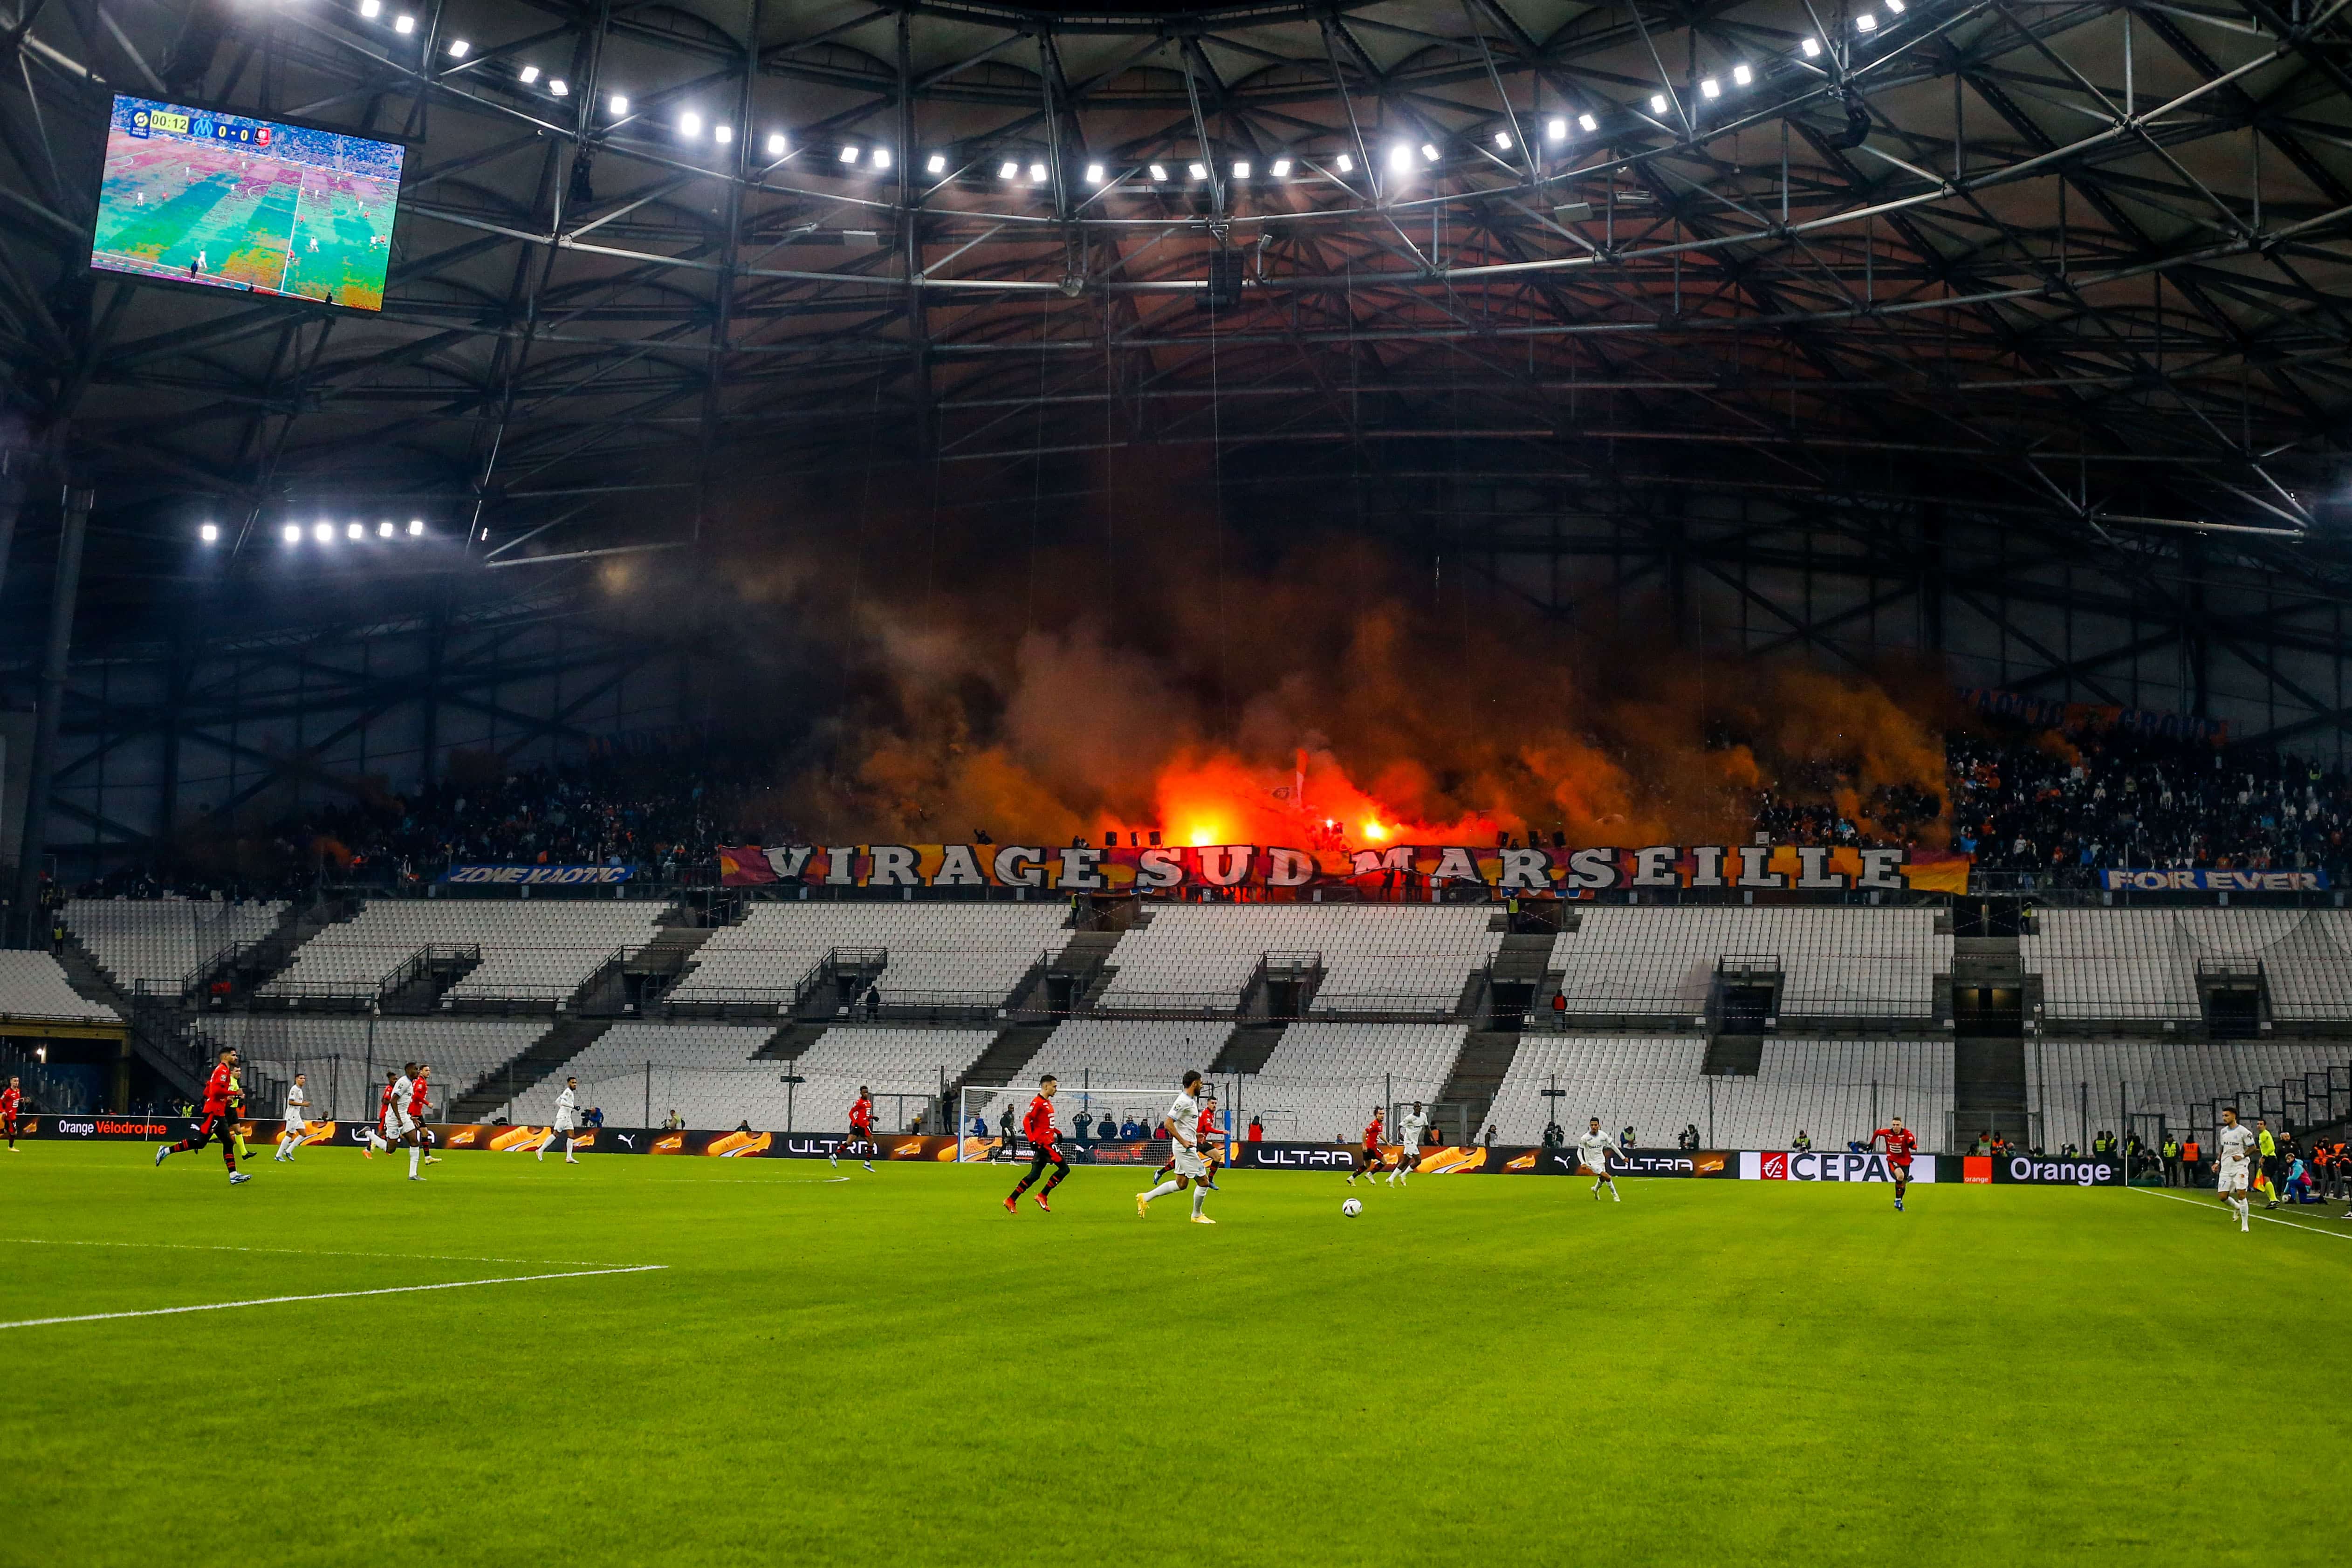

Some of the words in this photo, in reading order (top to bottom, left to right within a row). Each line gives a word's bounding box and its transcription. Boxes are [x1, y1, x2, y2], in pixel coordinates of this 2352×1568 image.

[151, 114, 187, 130] 00:12
[450, 867, 530, 883] ZONE
[521, 867, 625, 884] KAOTIC
[762, 845, 1101, 888] VIRAGE
[1135, 845, 1313, 887] SUD
[1352, 847, 1903, 889] MARSEILLE
[2108, 871, 2200, 890] FOR
[2206, 871, 2321, 891] EVER
[59, 1120, 94, 1137] Orange
[96, 1120, 166, 1135] Vélodrome
[1257, 1150, 1353, 1165] ULTRA
[1610, 1157, 1694, 1171] ULTRA
[2010, 1157, 2111, 1186] Orange
